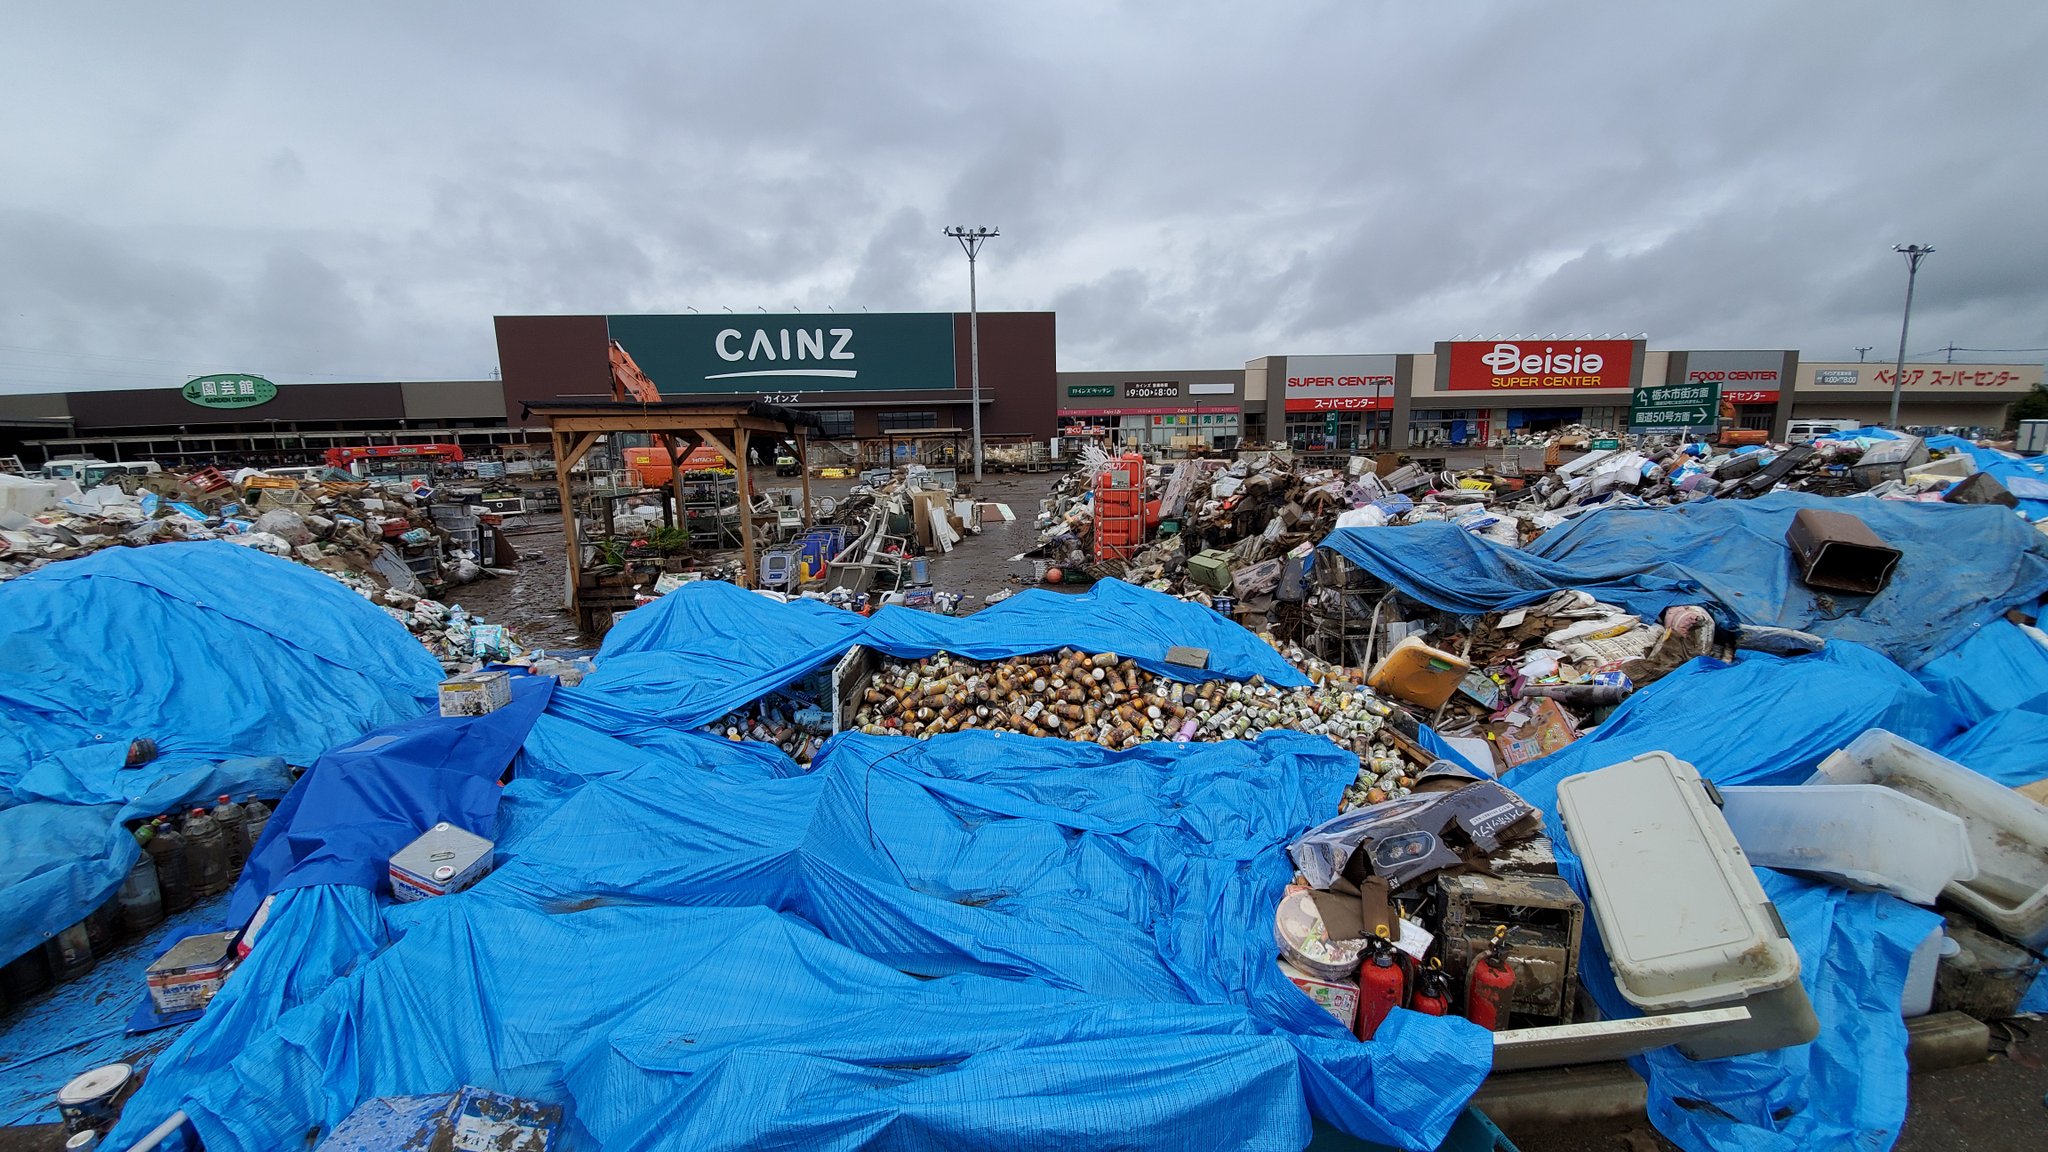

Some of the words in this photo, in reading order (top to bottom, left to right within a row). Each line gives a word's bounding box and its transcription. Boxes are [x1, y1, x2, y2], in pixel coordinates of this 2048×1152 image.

[715, 328, 855, 362] CAINZ
[1481, 343, 1604, 375] Beisia
[1288, 377, 1334, 387] SUPER
[1337, 376, 1394, 386] CENTER
[1491, 376, 1539, 388] SUPER
[1542, 376, 1601, 387] CENTER
[1689, 371, 1725, 382] FOOD
[1728, 371, 1777, 380] CENTER
[1874, 370, 1924, 385] ベイシア
[1930, 371, 2019, 386] スーパーセンター
[201, 380, 255, 396] 園芸館
[1130, 388, 1150, 397] 9:00
[1158, 387, 1178, 396] 8:00
[1652, 387, 1709, 400] 栃木市街方面
[764, 394, 799, 403] カインズ
[1722, 393, 1766, 401] ードセンター
[1315, 399, 1375, 408] スーパーセンター
[1635, 411, 1691, 423] 国道50号方面
